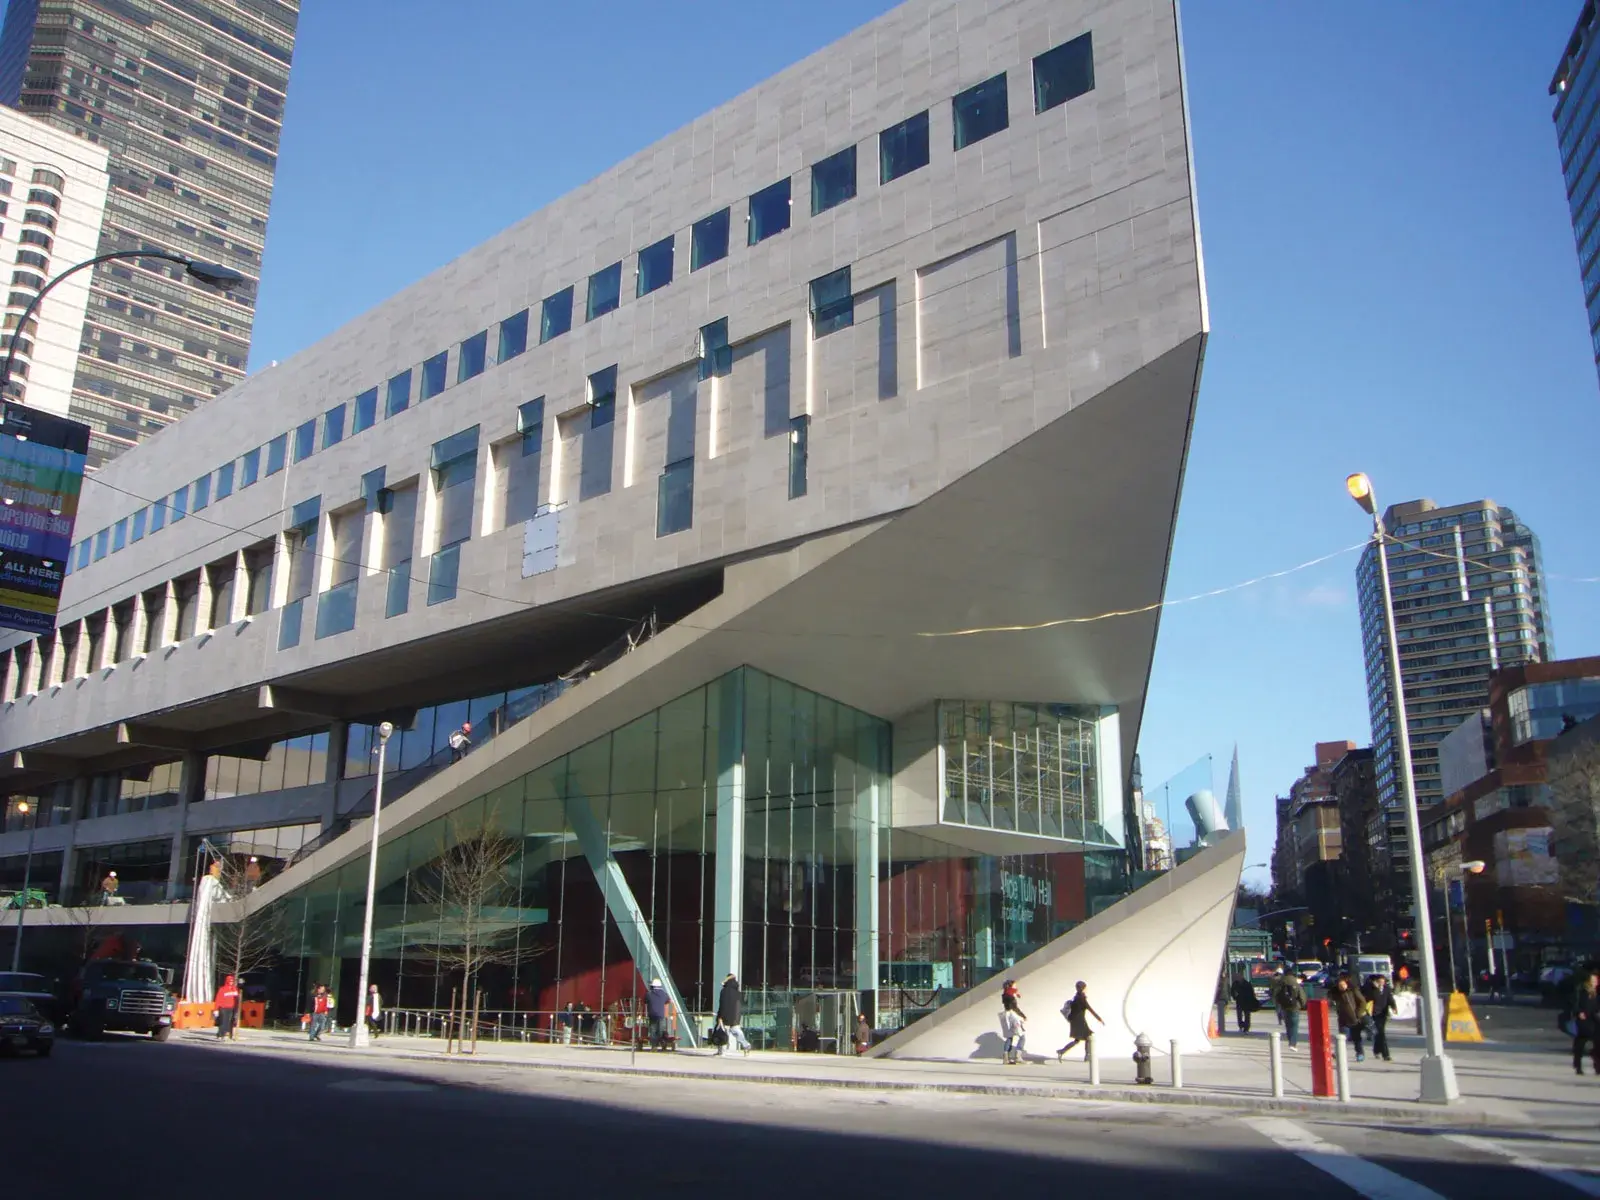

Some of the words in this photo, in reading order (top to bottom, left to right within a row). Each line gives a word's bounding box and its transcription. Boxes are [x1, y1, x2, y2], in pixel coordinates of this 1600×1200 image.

[4, 561, 26, 573] ALL
[29, 566, 61, 580] HERE
[1018, 874, 1037, 909] Tully
[1038, 879, 1052, 907] Hall
